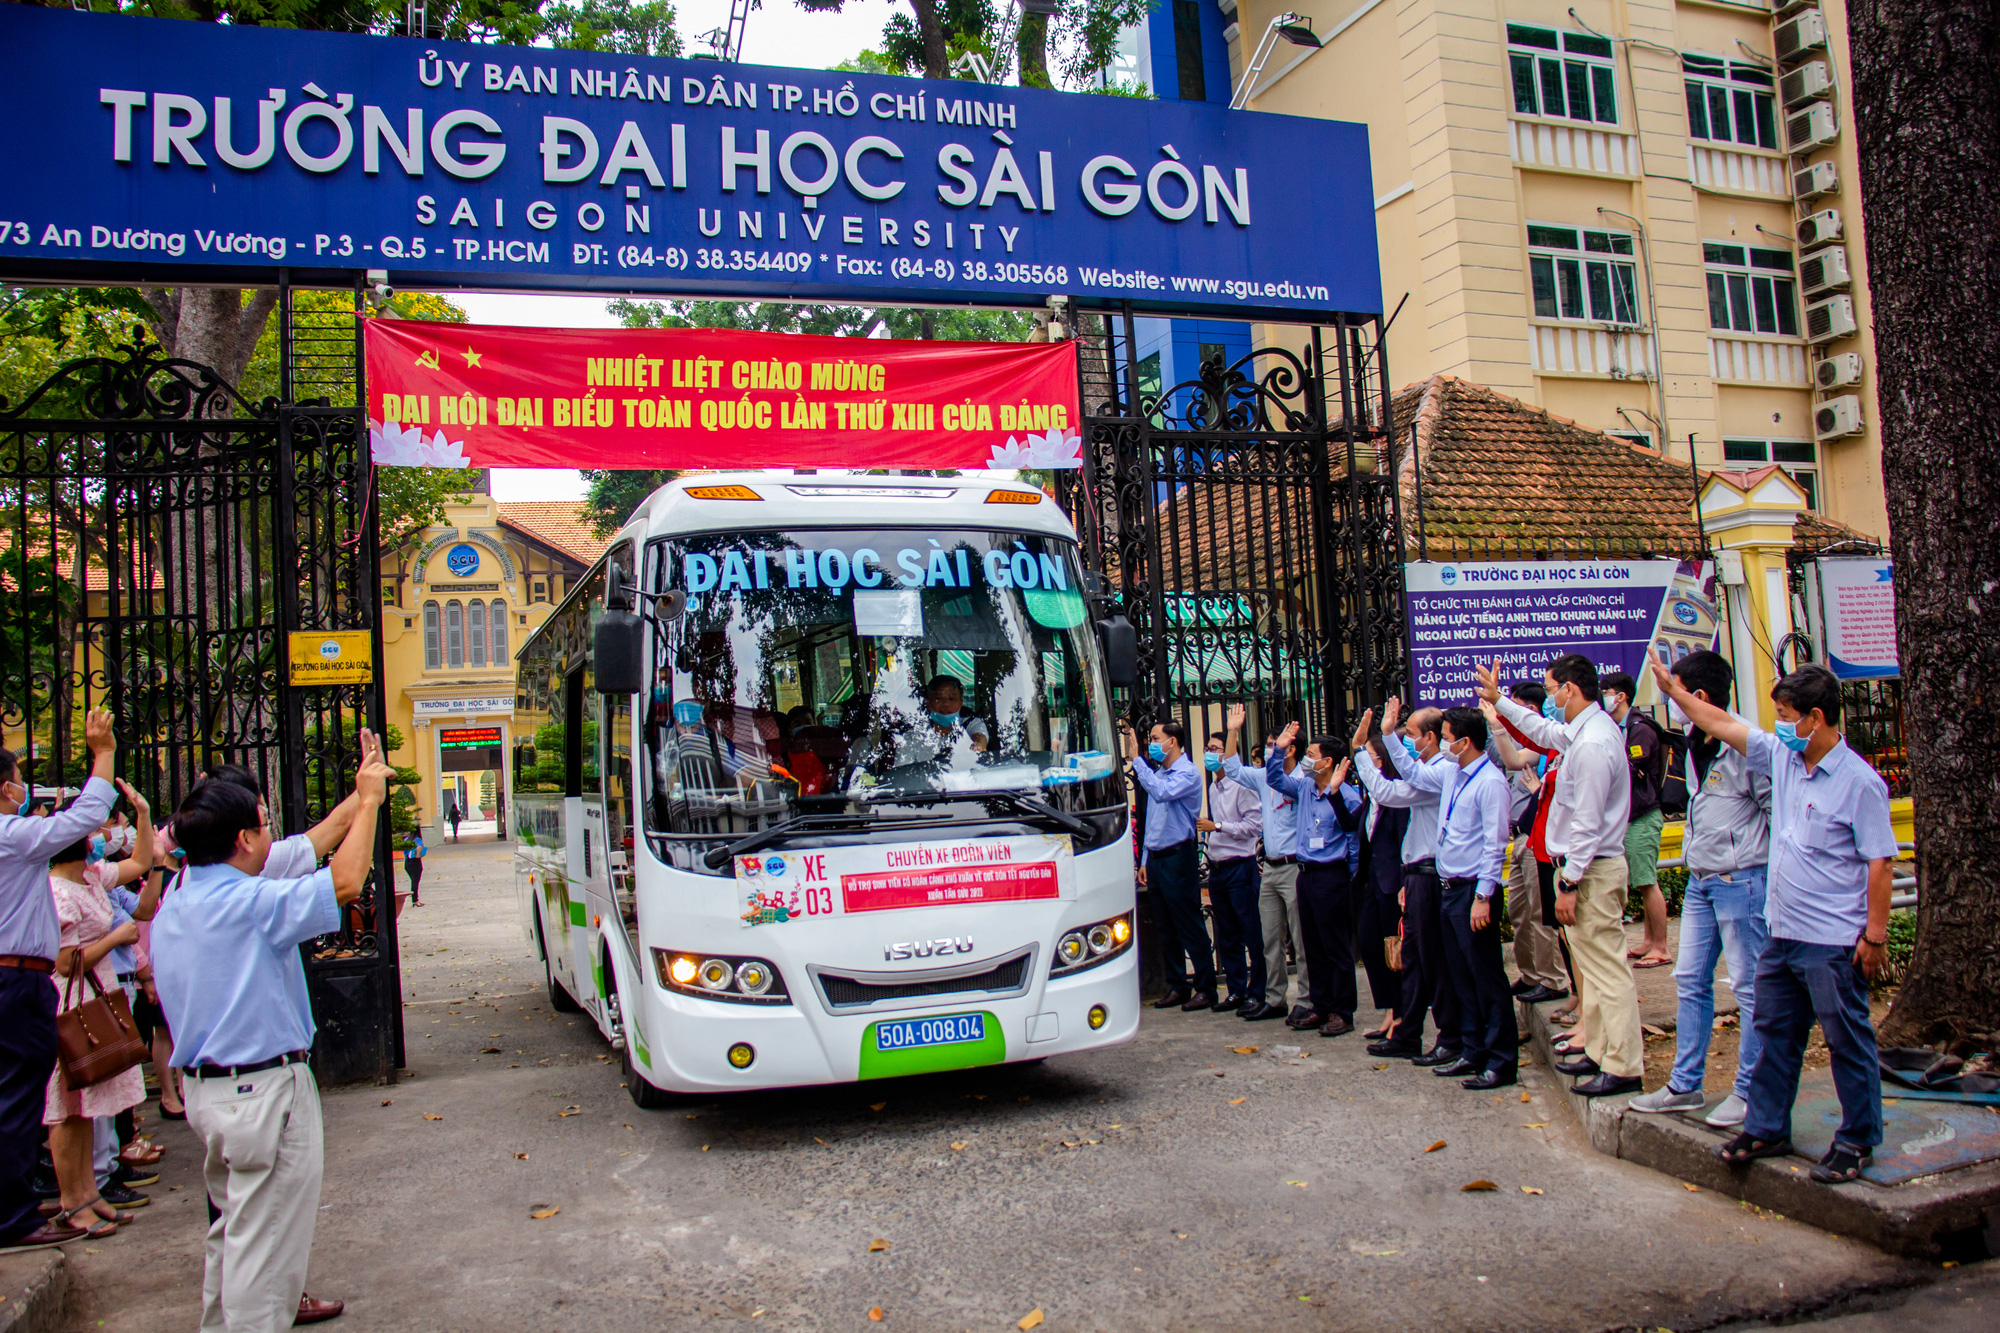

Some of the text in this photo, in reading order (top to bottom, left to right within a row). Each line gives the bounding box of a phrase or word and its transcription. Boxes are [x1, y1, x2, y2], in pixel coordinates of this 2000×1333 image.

[419, 49, 1017, 128] ỦY BAN NHÂN DÂN TP.HỒ CHÍ MINH
[100, 81, 1251, 225] TRƯỜNG ĐẠI HỌC SÀI GÒN
[416, 195, 1020, 252] SAIGON UNIVERSITY
[40, 223, 81, 247] An
[91, 225, 185, 256] Dương
[194, 229, 286, 260] Vương
[315, 234, 354, 256] P.3
[380, 236, 426, 259] Q.5
[452, 238, 549, 263] TP.HCM
[573, 243, 608, 265] ĐT:
[617, 245, 688, 271] (84-8)
[695, 248, 812, 273] 38.354409
[836, 254, 883, 275] Fax:
[890, 257, 955, 282] (84-8)
[961, 261, 1069, 285] 38.305568
[1078, 266, 1166, 291] Website:
[1170, 276, 1330, 301] www.sgu.edu.vn
[586, 353, 886, 394] NHIỆT LIỆT CHÀO MỪNG
[381, 387, 1068, 432] ĐẠI HỘI ĐẠI BIỂU TOÀN QUỐC LẦN THỨ XIII CỦA ĐẢNG
[450, 555, 476, 566] SGU
[684, 538, 1067, 599] ĐẠI HỌC SÀI GÒN
[1462, 566, 1630, 583] TRƯỜNG ĐẠI HỌC SÀI GÒN
[1413, 593, 1626, 610] TỔ CHỨC THI ĐÁNH GIÁ VÀ CẤP CHỨNG CHỈ
[1414, 607, 1647, 626] NĂNG LỰC TIẾNG ANH THEO KHUNG NĂNG LỰC
[1415, 623, 1616, 644] NGOẠI NGỮ 6 BẬC DÙNG CHO VIỆT NAM
[293, 659, 369, 672] TRƯỜNG ĐẠI HỌC SÀI GÒN
[1417, 654, 1433, 668] TỔ
[1435, 653, 1470, 667] CHỨC
[1472, 654, 1491, 665] THI
[1529, 650, 1549, 663] GIÁ
[1418, 670, 1442, 684] CẤP
[1512, 665, 1529, 679] VỀ
[420, 700, 450, 709] TRƯỜNG
[468, 699, 484, 708] HỌC
[487, 698, 499, 706] SÀI
[502, 697, 515, 706] GÒ
[1419, 686, 1436, 700] SỬ
[1439, 686, 1474, 701] DỤNG
[767, 862, 785, 870] SGU
[886, 841, 1011, 868] CHUYẾN XE ĐOÀN VIÊN
[803, 854, 828, 882] XE
[805, 887, 833, 916] 03
[927, 888, 943, 901] XUÂN
[943, 887, 956, 899] TÂN
[969, 886, 984, 898] 2021
[883, 935, 974, 962] ISUZU
[880, 1016, 981, 1047] 50A-008.04
